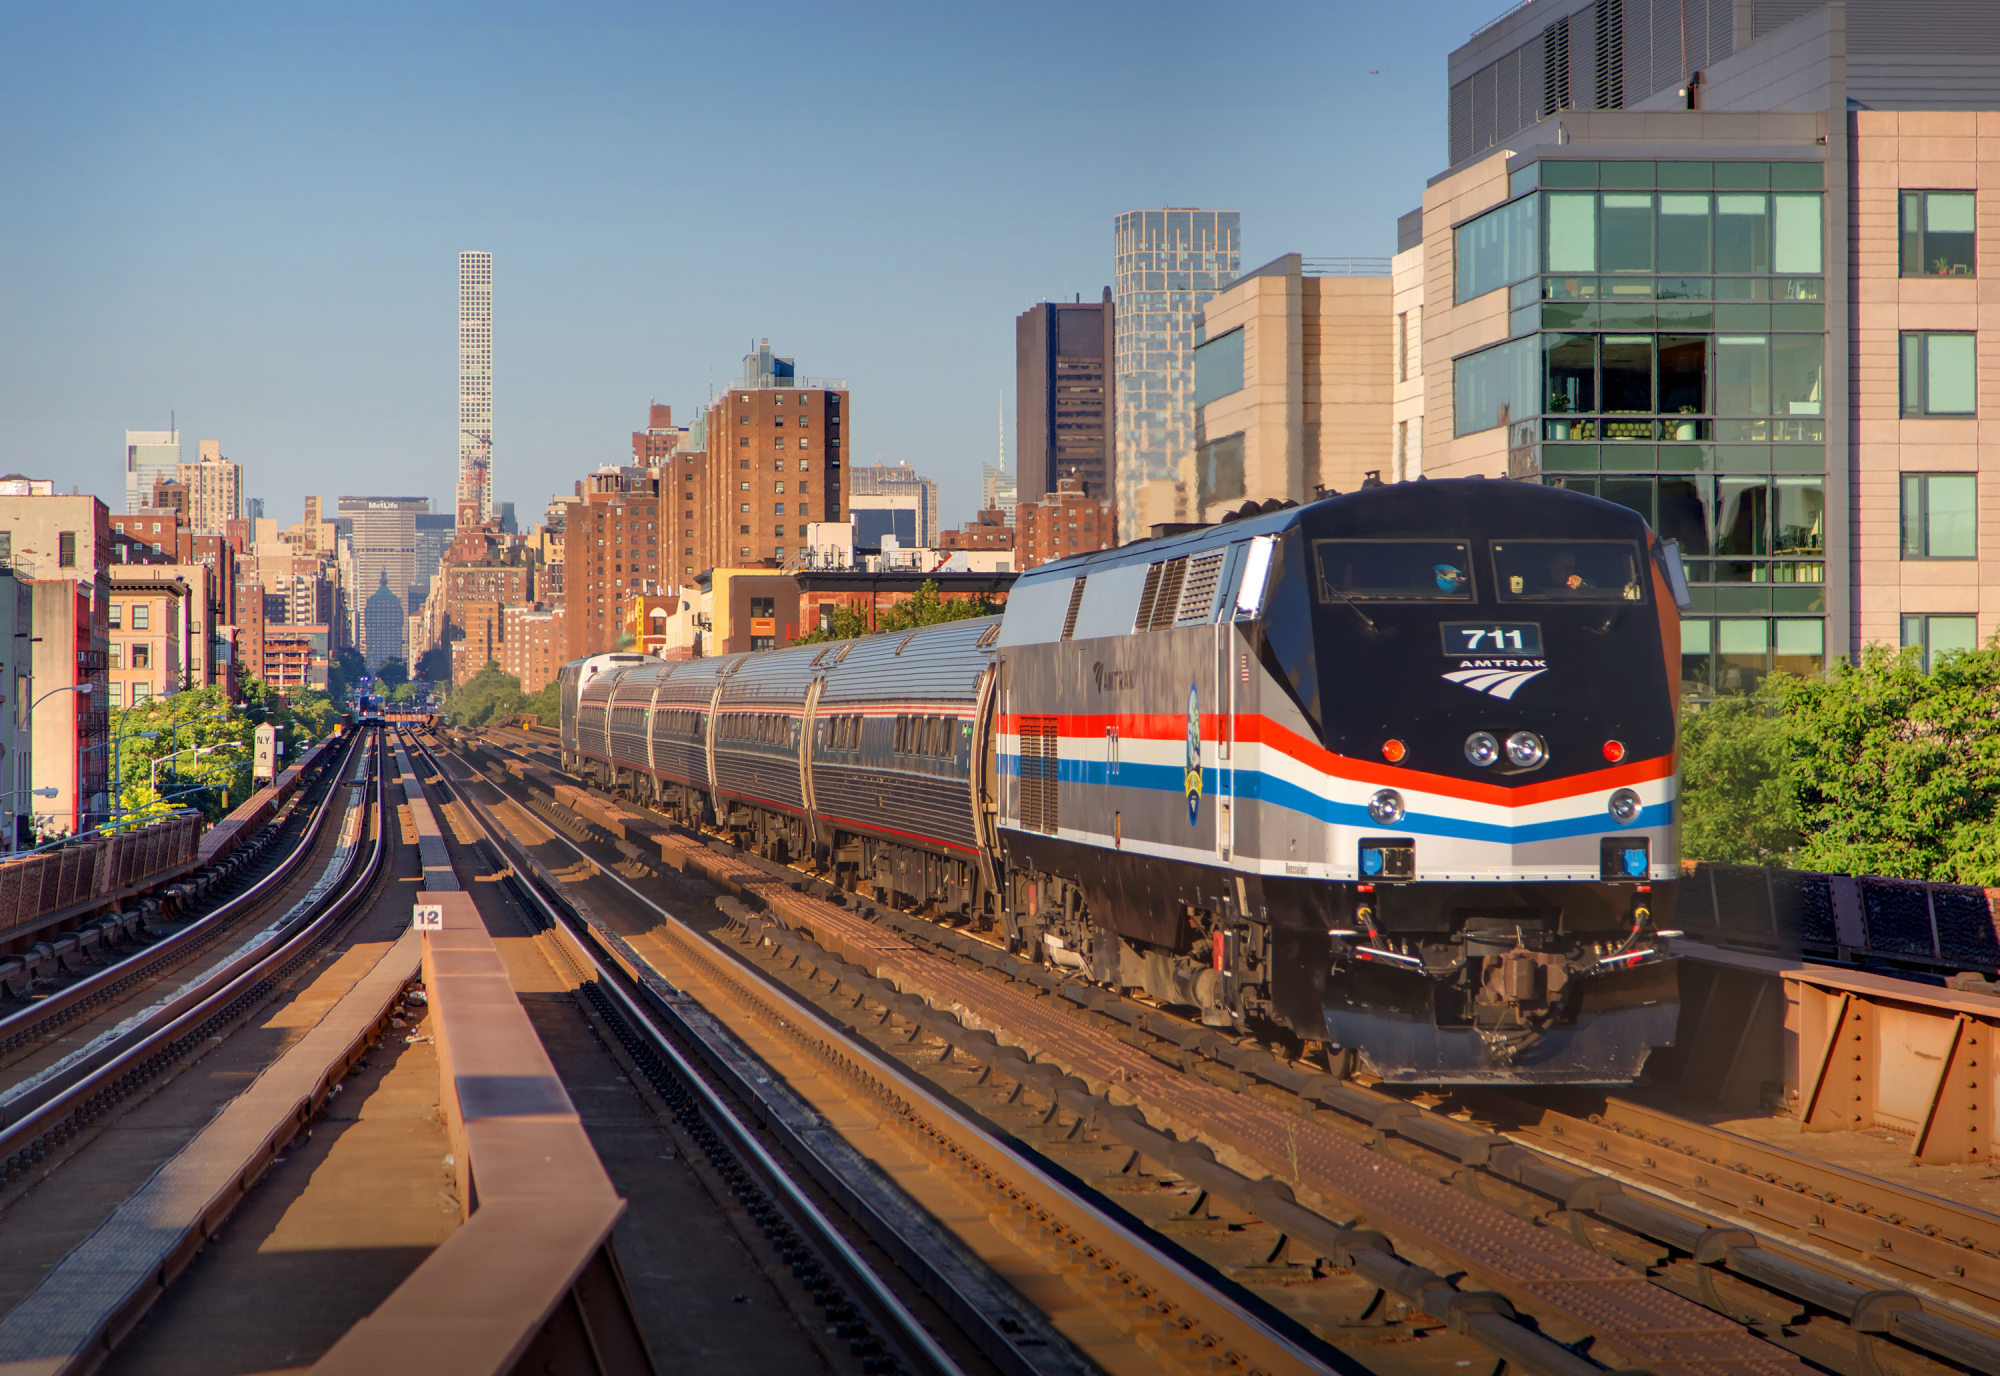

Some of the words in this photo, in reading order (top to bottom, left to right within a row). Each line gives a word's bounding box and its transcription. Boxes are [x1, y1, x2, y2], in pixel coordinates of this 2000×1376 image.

[368, 501, 399, 509] MetLife
[1461, 629, 1523, 650] 711
[1459, 659, 1548, 669] AMTRAK
[1103, 669, 1134, 691] AMTRAK
[256, 735, 272, 745] N.Y.
[259, 751, 267, 760] 4
[417, 910, 439, 925] 12
